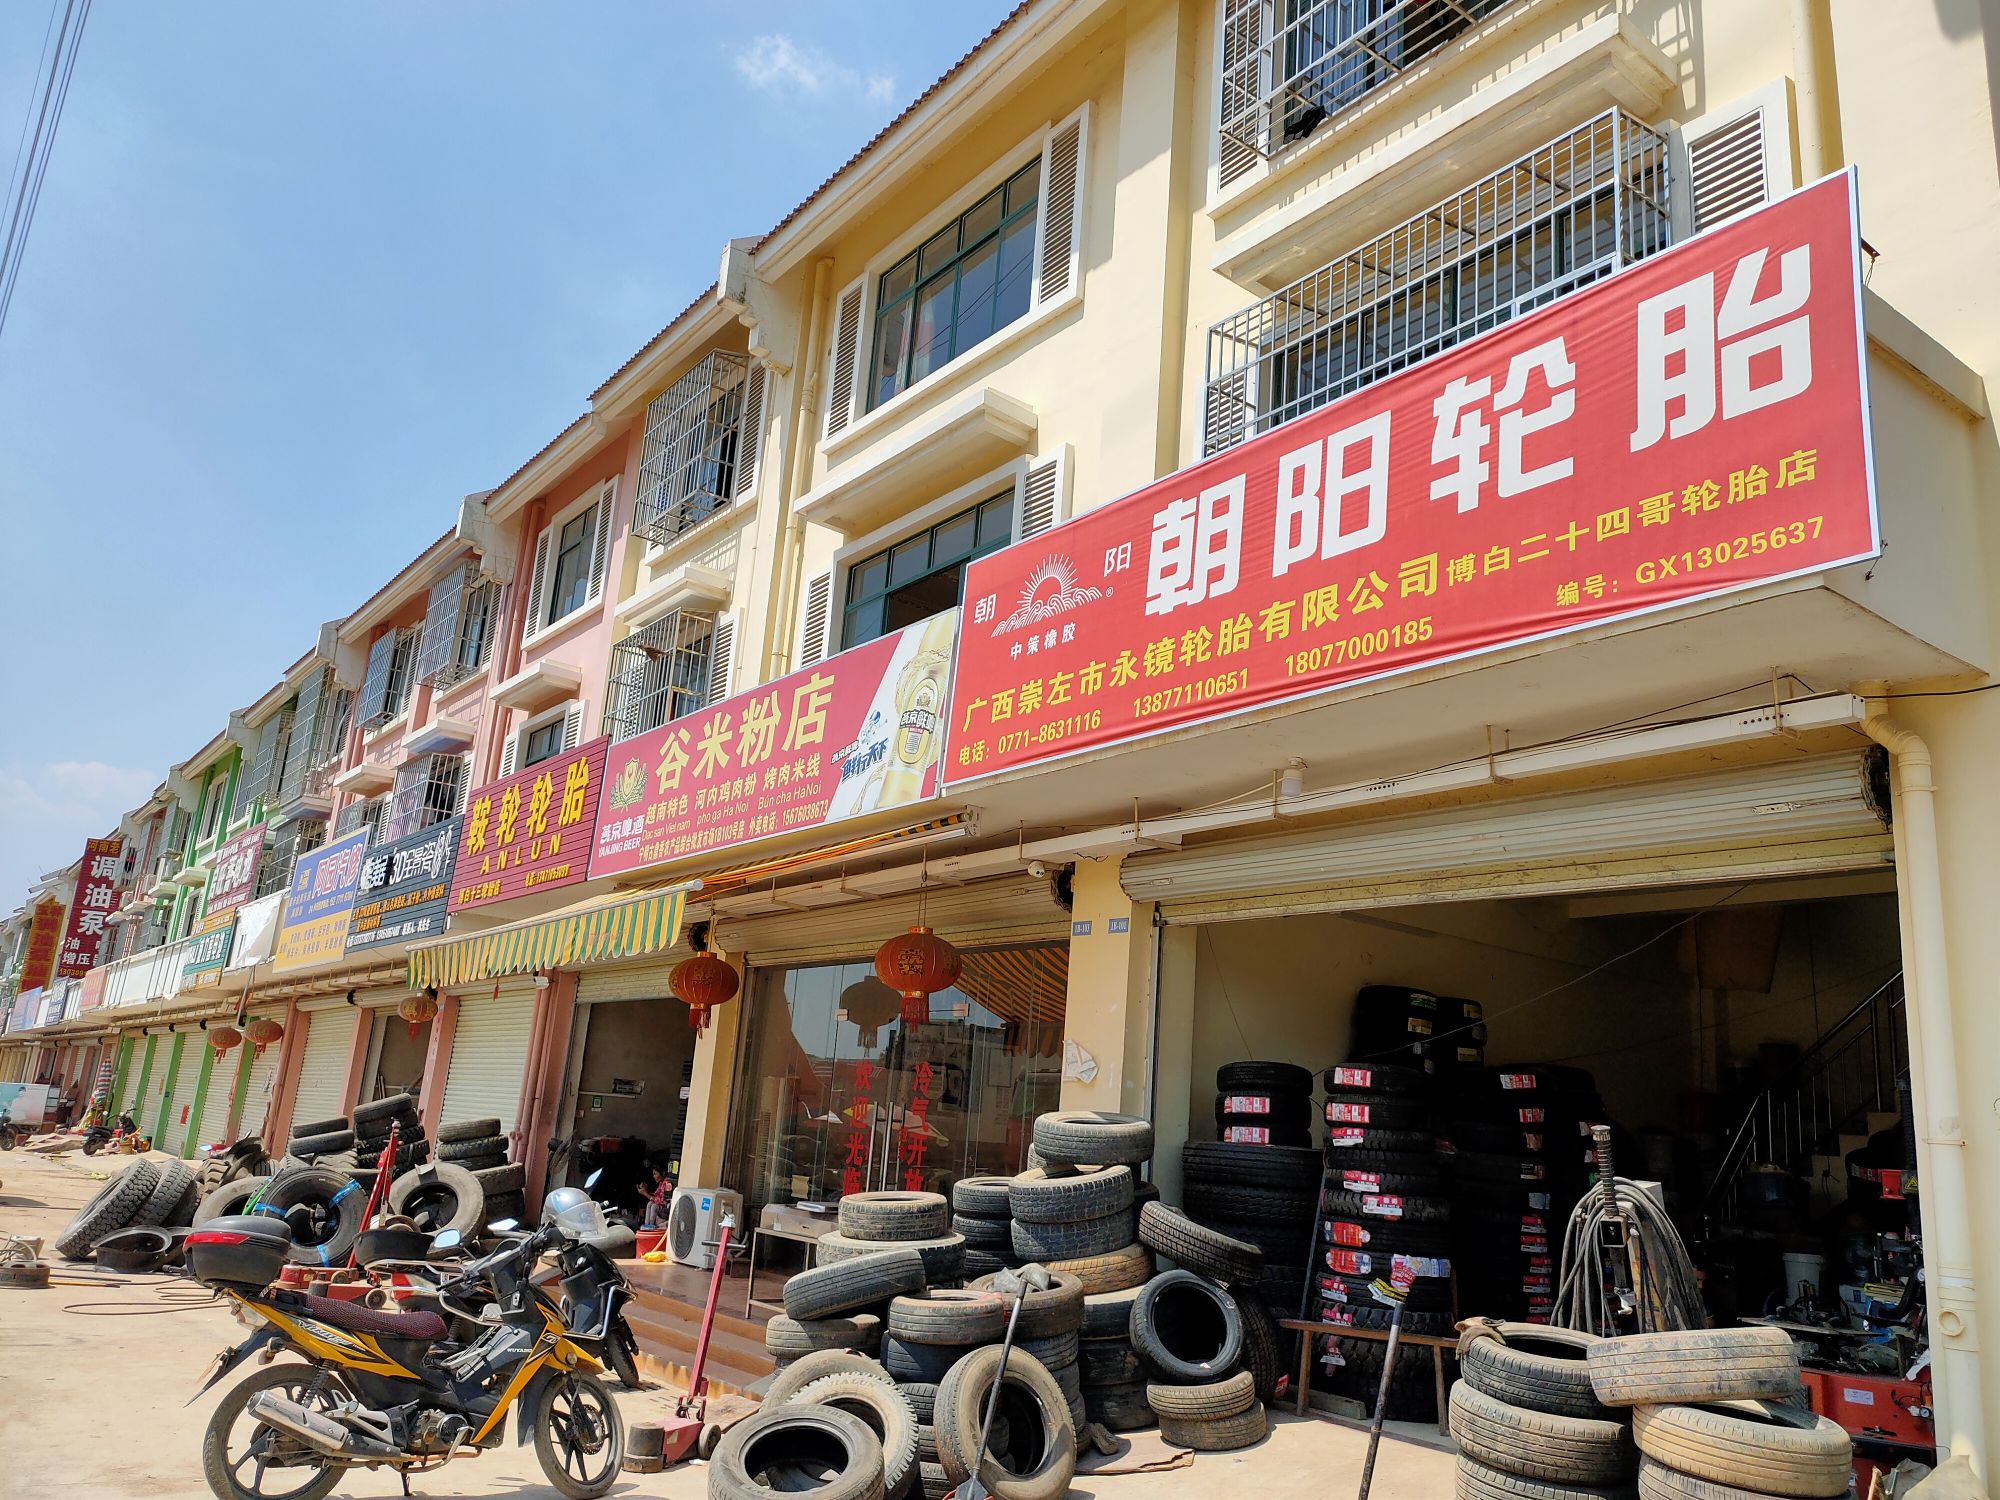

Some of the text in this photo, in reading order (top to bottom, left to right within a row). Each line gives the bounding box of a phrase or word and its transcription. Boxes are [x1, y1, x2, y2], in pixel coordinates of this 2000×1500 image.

[1145, 244, 1813, 616] 朝阳轮胎
[963, 449, 1818, 733] 广西崇左市永镜轮胎有限公司 博白二十四哥轮胎店
[973, 541, 1132, 624] 朝 阳
[1635, 516, 1825, 585] GX13025637
[1010, 622, 1077, 660] 中策橡胶
[998, 709, 1101, 754] 0771-8631116
[1133, 668, 1249, 718] 13877110651
[1285, 616, 1433, 677] 18077000185
[655, 671, 835, 796] 谷米粉店
[466, 756, 590, 856] 鞍轮轮胎
[600, 814, 646, 845] 燕京啤酒
[645, 752, 821, 826] 越南特色 河内鸡肉粉 烤肉米线
[776, 791, 792, 805] cha
[480, 833, 562, 875] ANLUN
[598, 837, 642, 858] YANJING BEER
[76, 855, 119, 936] 调油泵
[842, 1057, 873, 1197] 欢迎光临
[904, 1061, 934, 1192] 冷气开放
